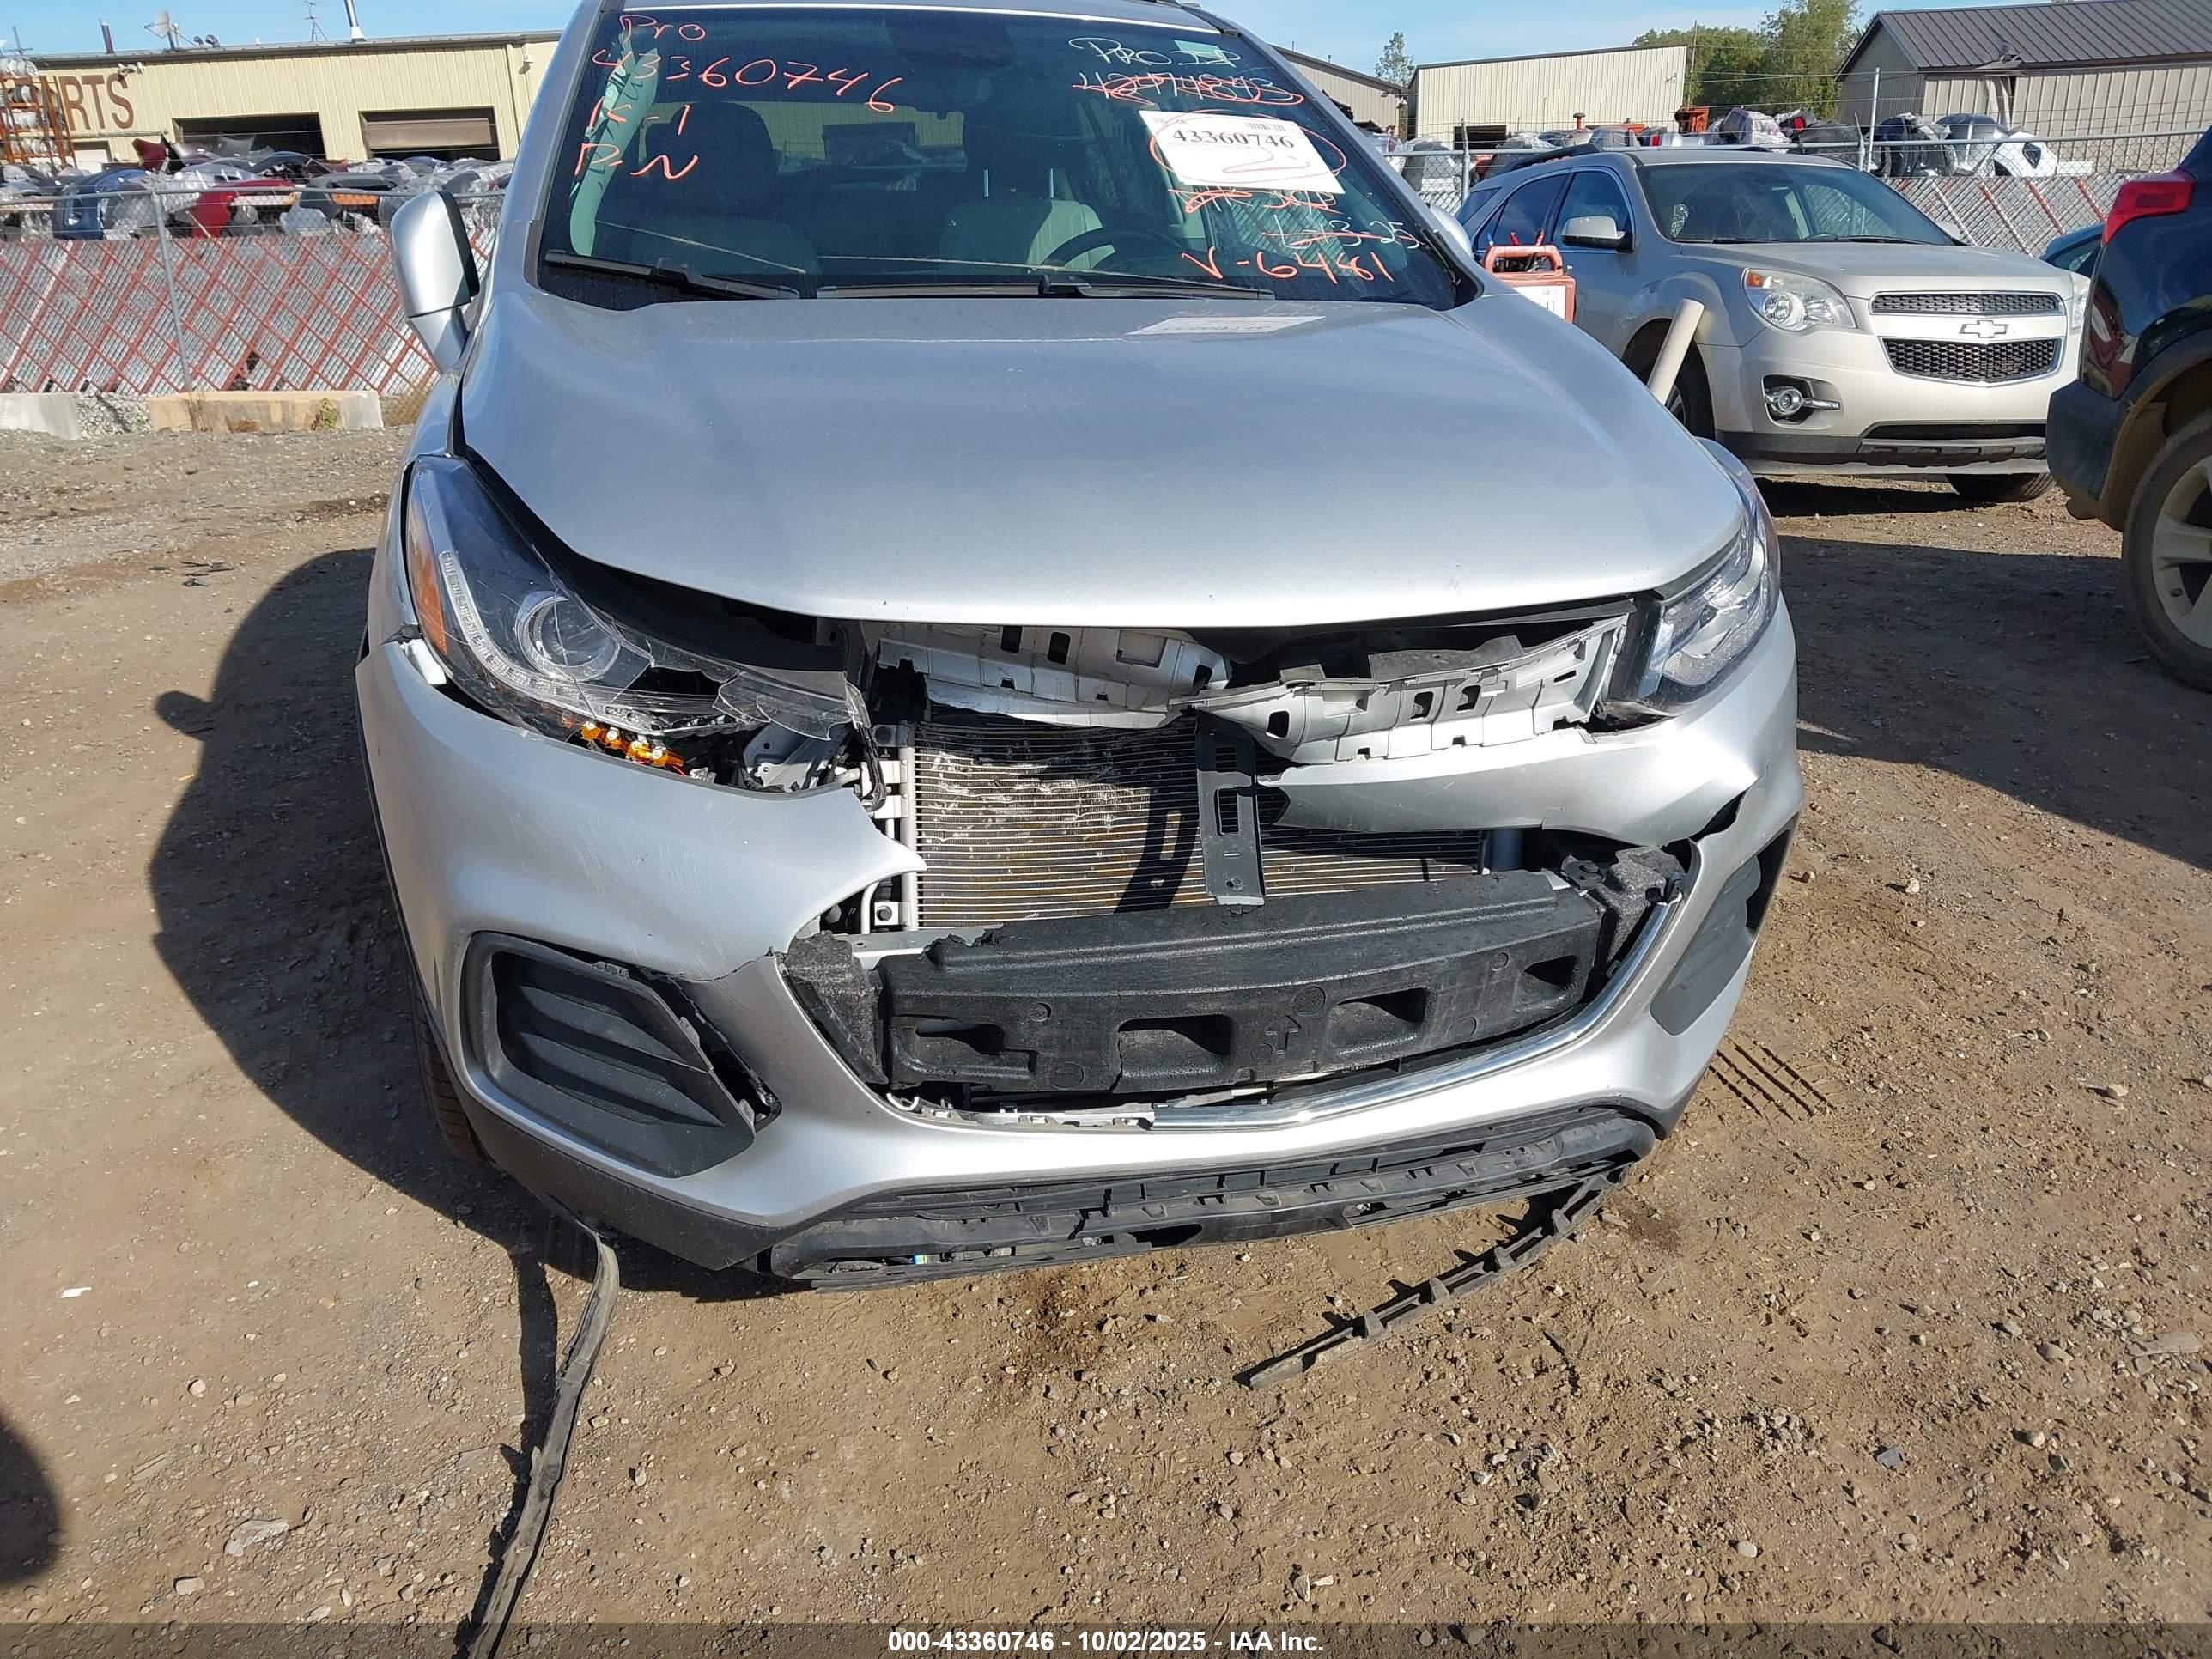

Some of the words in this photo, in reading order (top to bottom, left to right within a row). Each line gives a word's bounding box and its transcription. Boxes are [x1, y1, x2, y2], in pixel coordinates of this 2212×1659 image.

[619, 15, 706, 42] Pro
[57, 72, 135, 131] RTS
[592, 49, 903, 112] 43360746
[1172, 128, 1296, 149] 43360746
